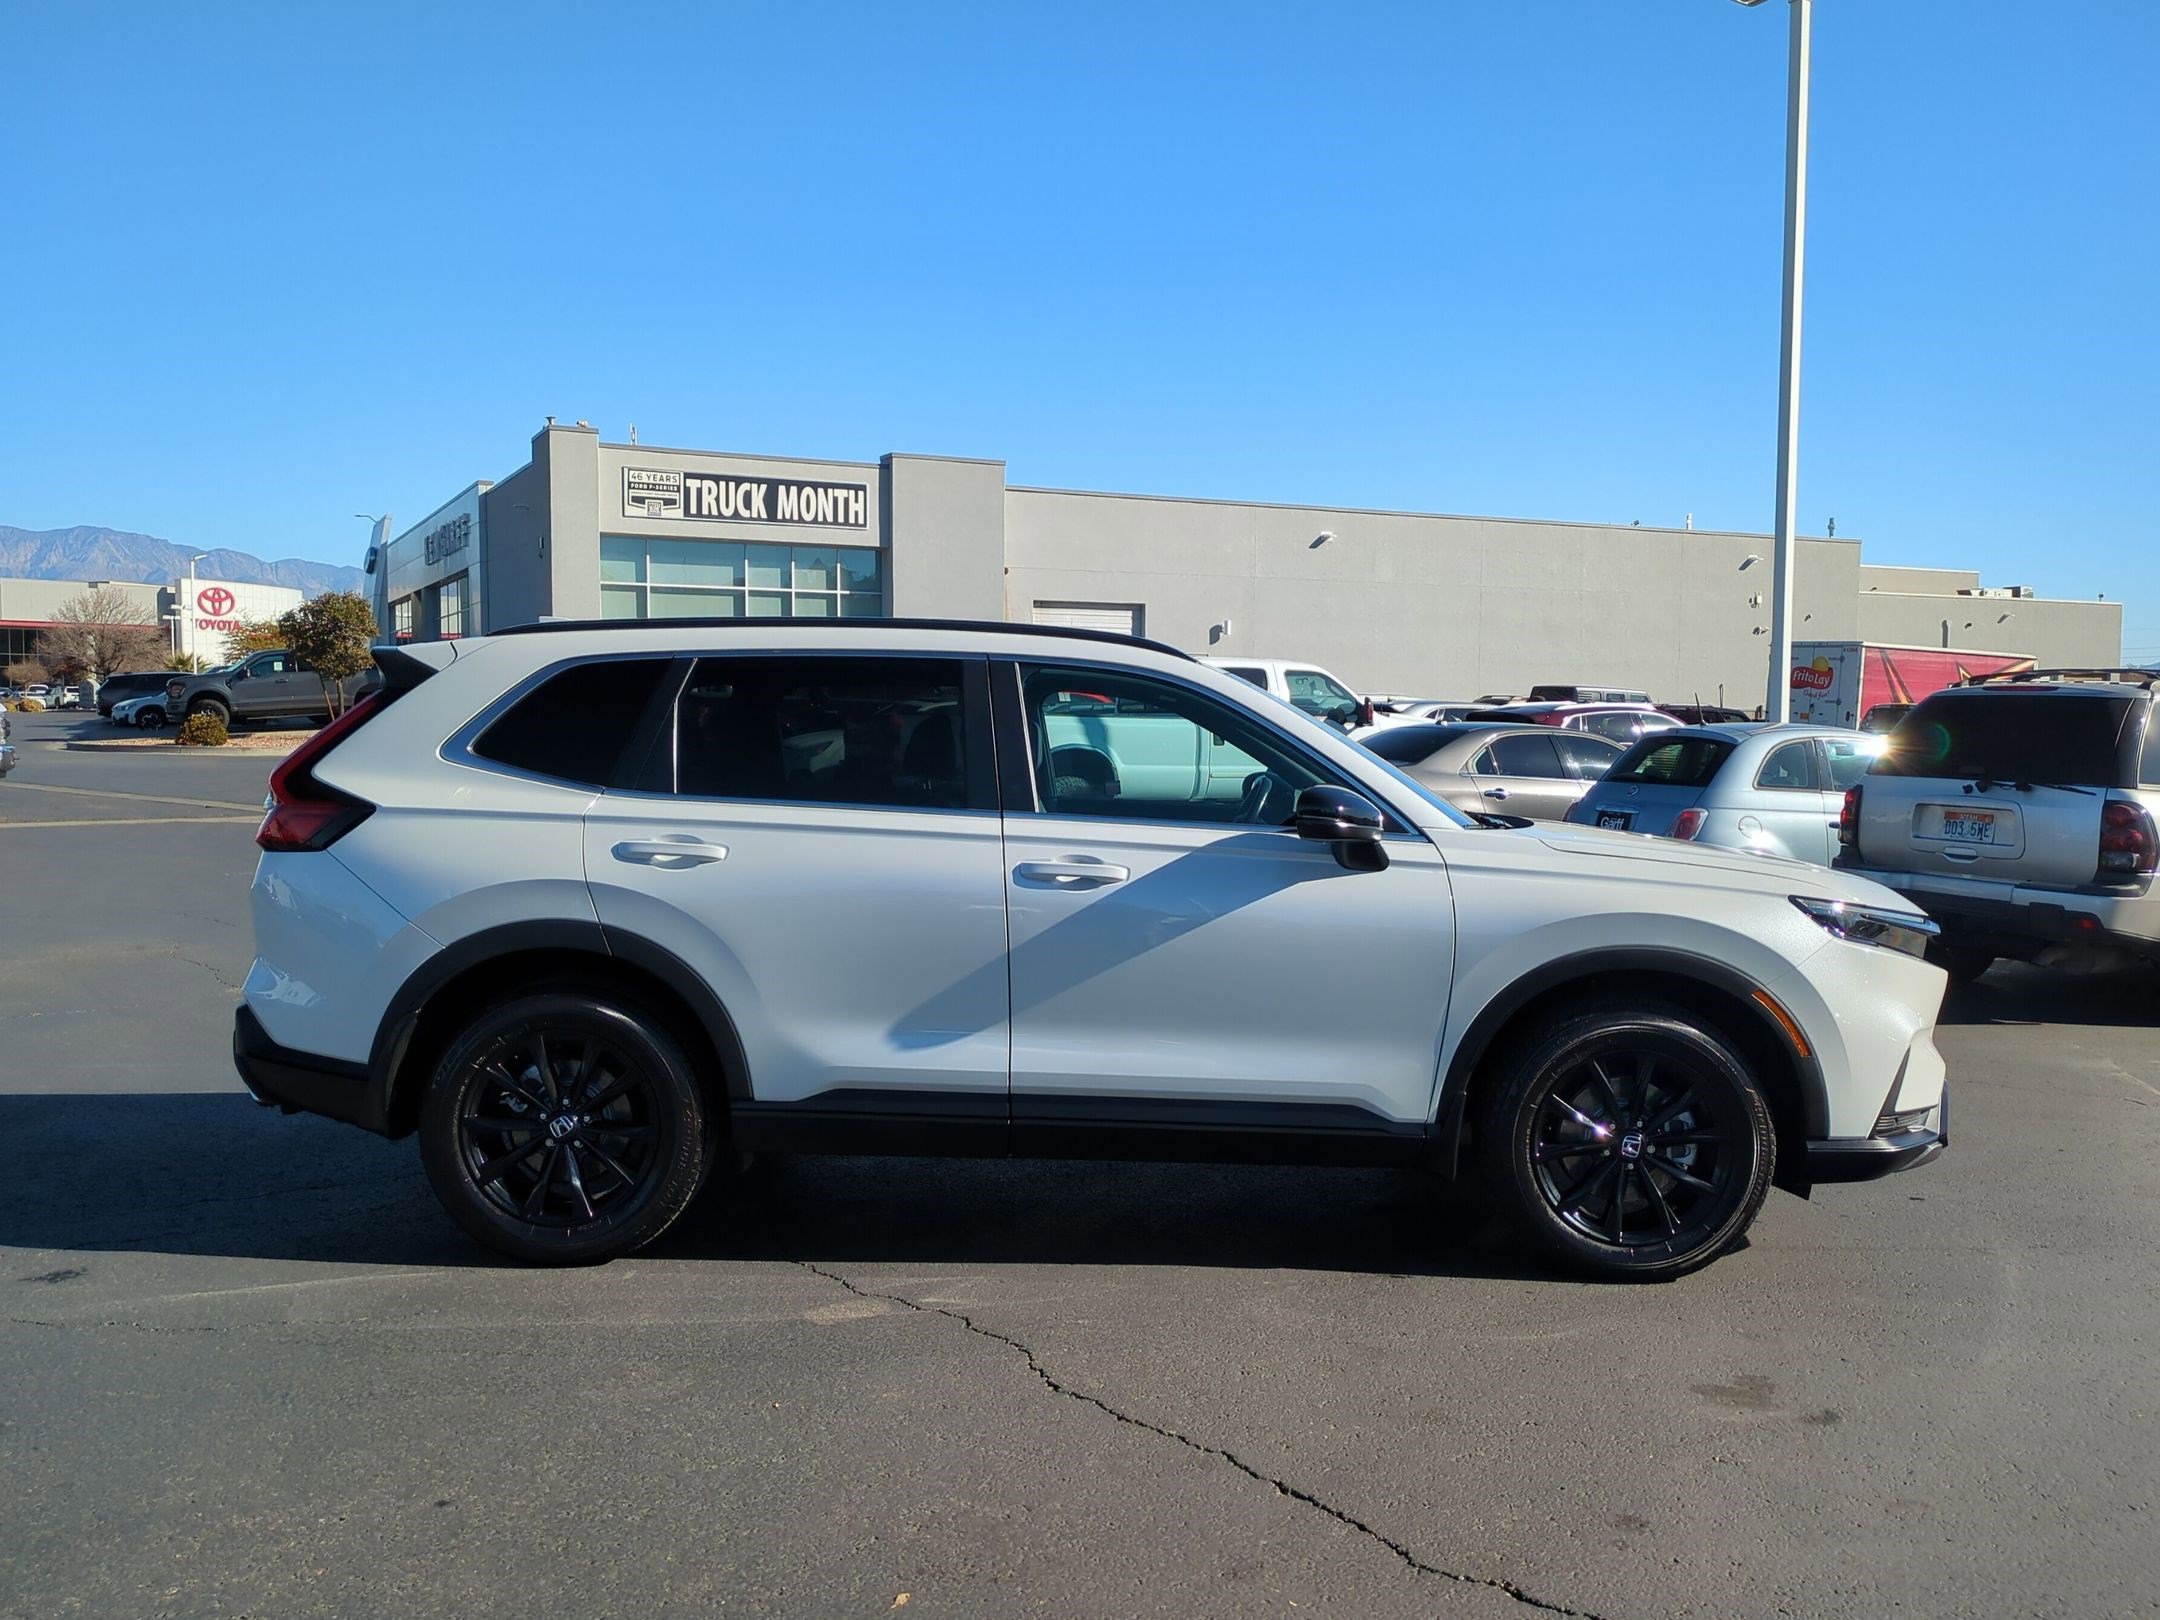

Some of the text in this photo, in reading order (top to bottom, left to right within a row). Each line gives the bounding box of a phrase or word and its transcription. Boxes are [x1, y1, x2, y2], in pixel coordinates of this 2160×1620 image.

[631, 472, 678, 484] 46 YEARS
[685, 478, 865, 525] TRUCK MONTH
[194, 617, 241, 632] TOYOTA
